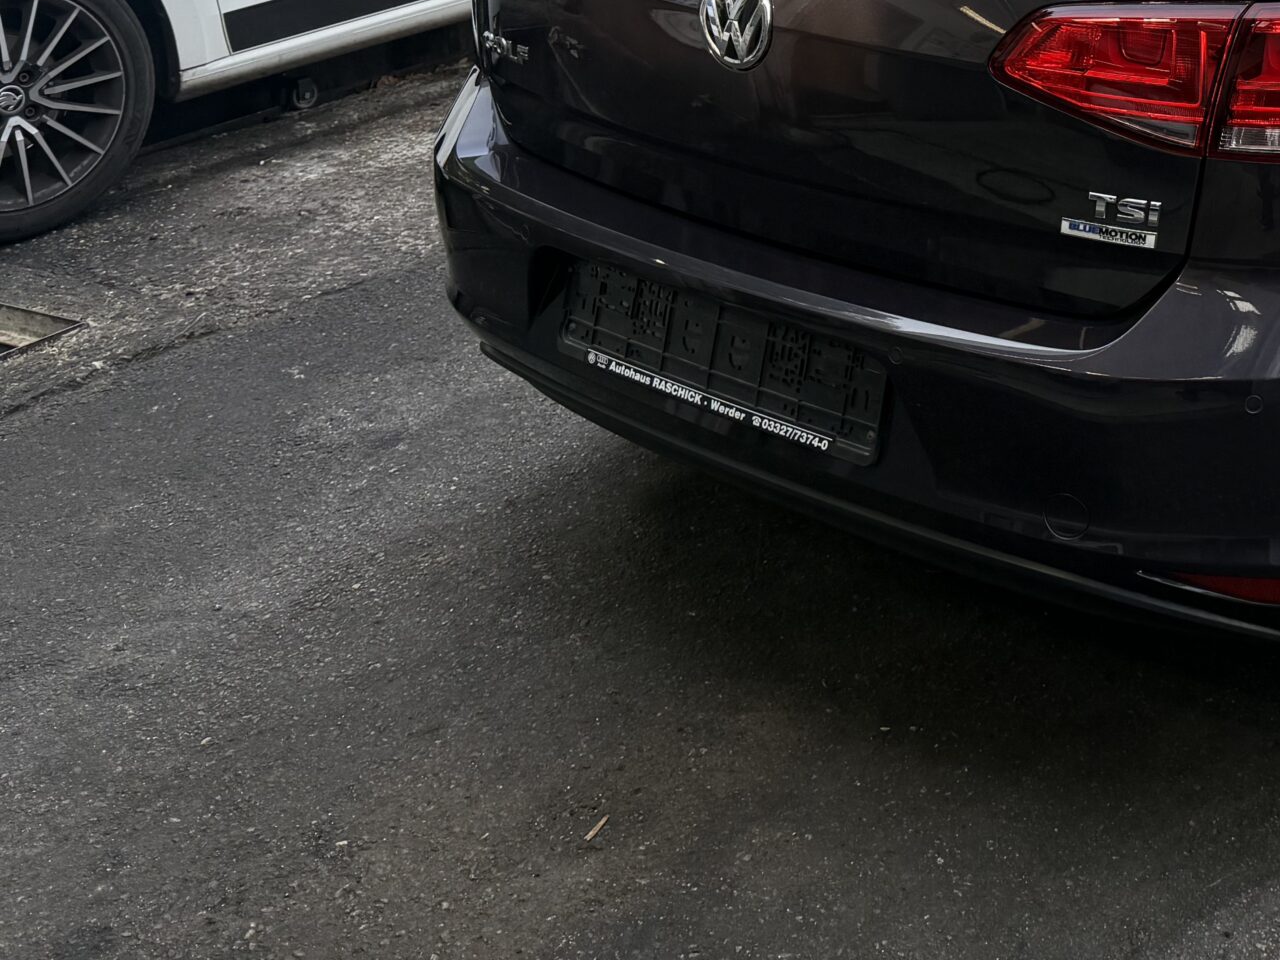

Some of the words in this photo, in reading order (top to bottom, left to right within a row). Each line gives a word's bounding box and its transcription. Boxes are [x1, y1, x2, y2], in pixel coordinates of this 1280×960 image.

[609, 360, 651, 385] Autohaus
[652, 377, 702, 406] RASCHICK
[710, 398, 746, 422] Werder
[761, 418, 829, 451] 03327/7374-0
